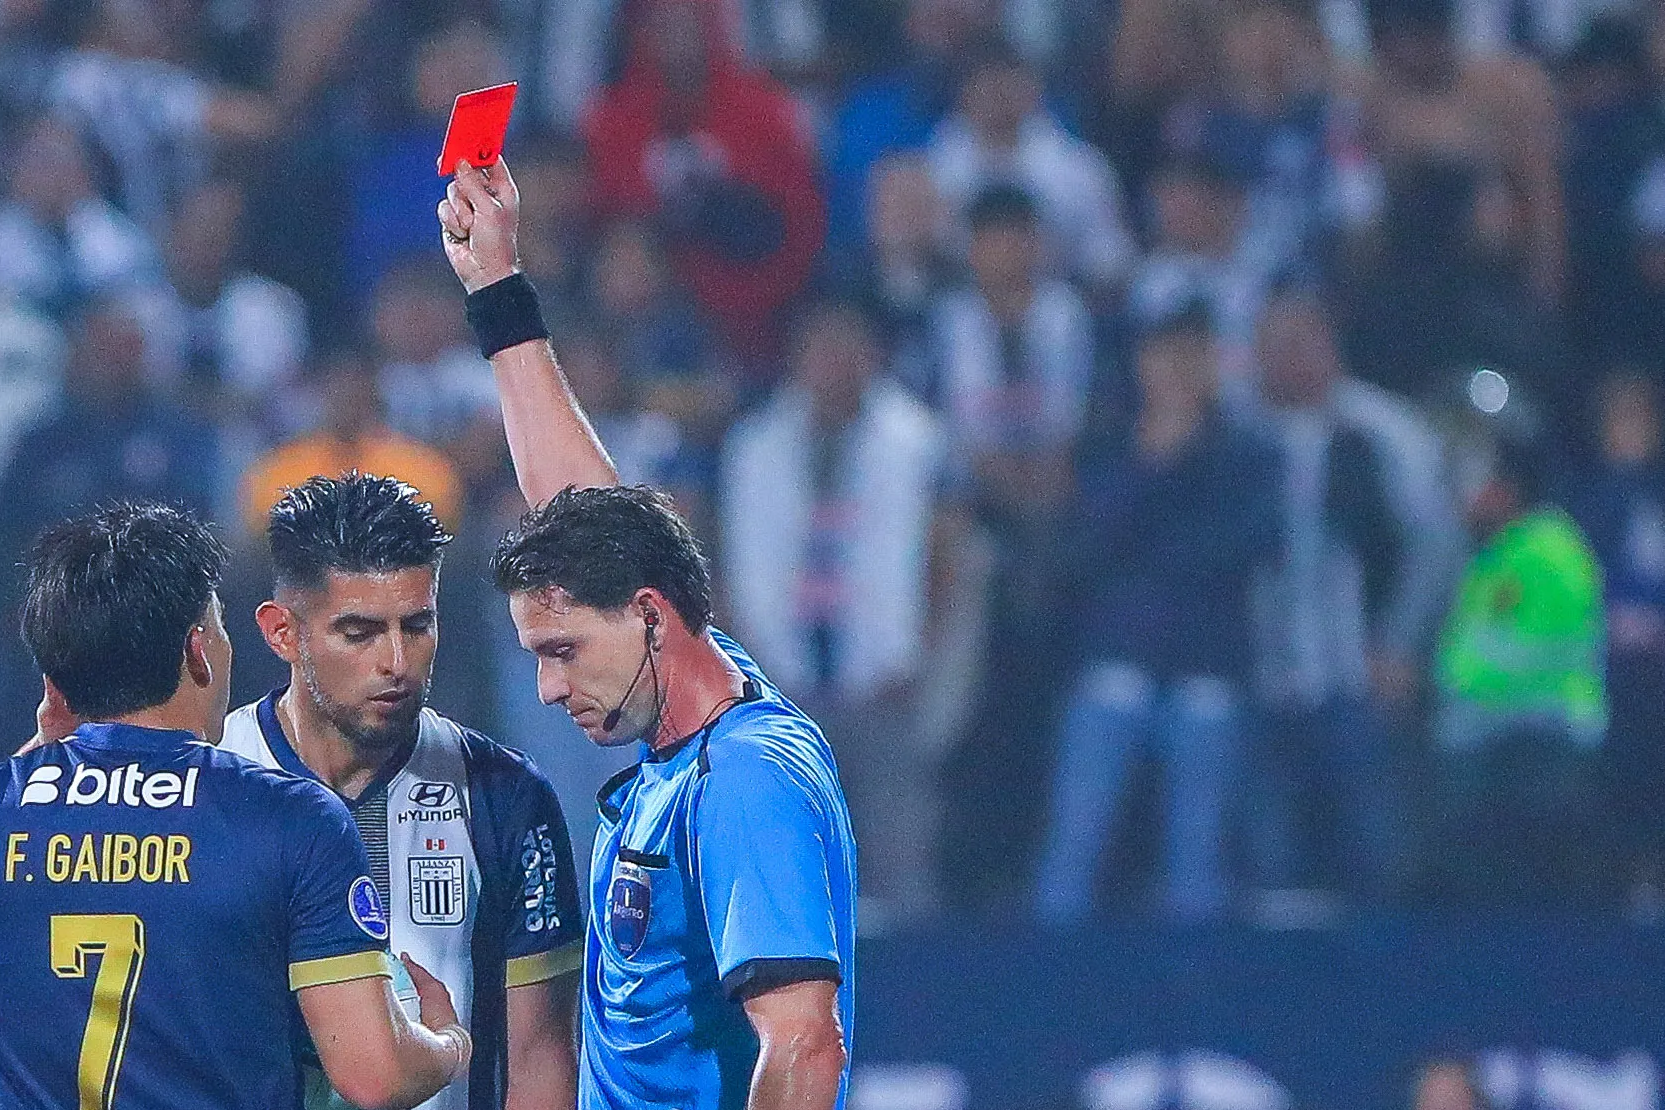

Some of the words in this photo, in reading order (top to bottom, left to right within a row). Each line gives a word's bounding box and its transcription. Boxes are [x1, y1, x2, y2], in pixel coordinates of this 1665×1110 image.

[66, 763, 200, 808] bitel
[398, 808, 465, 825] HYUNDA
[5, 832, 34, 883] F.
[46, 832, 193, 884] GAIBOR
